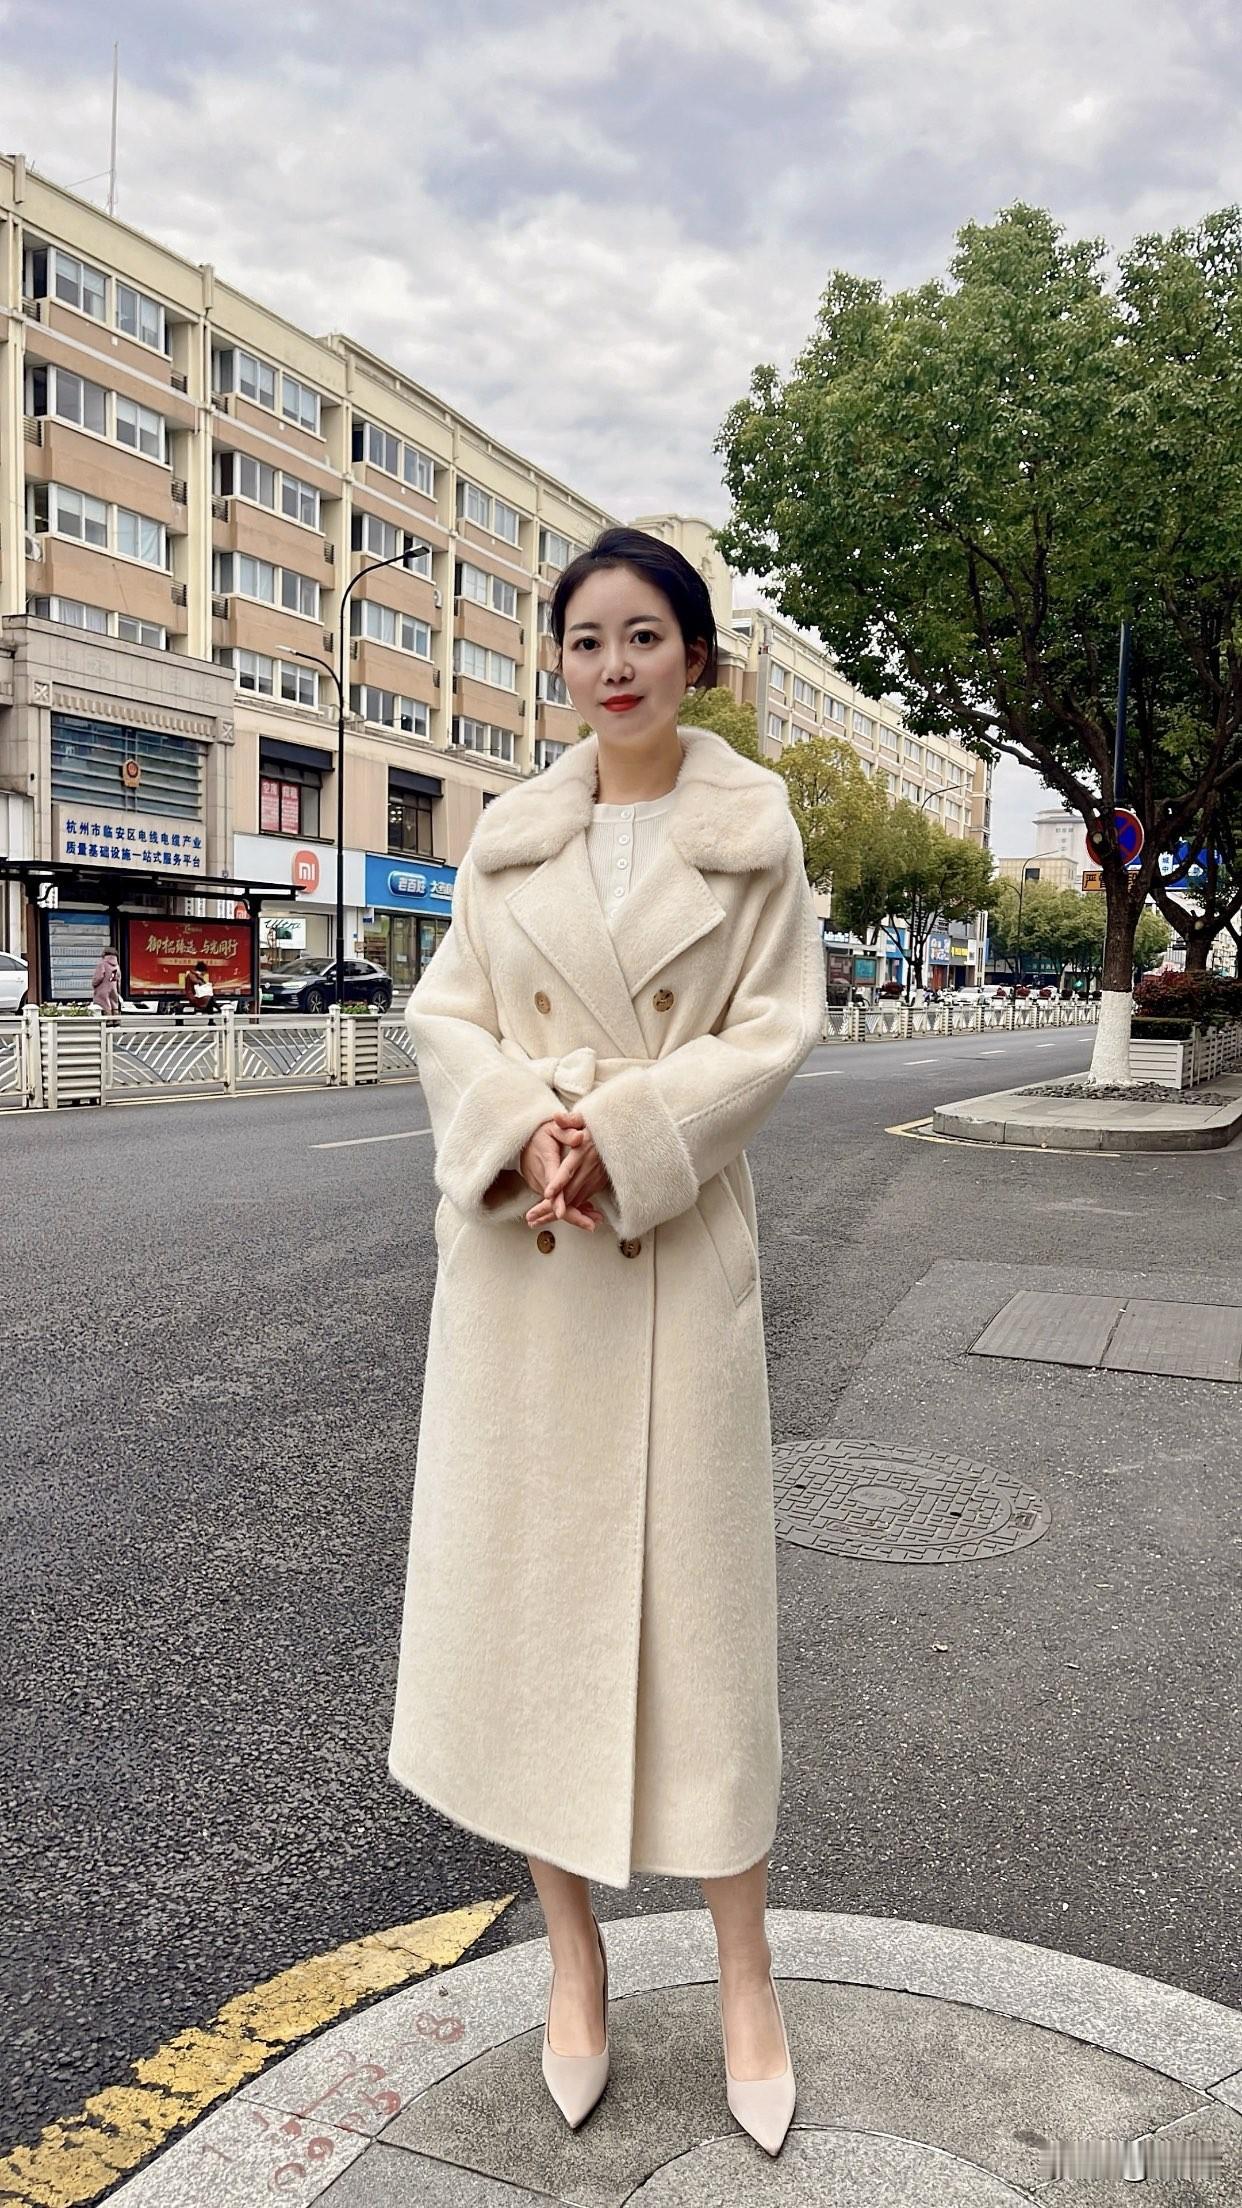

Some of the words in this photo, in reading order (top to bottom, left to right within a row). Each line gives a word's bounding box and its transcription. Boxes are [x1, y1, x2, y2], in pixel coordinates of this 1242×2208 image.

[66, 819, 202, 849] 杭州市临安区电线电缆产业
[66, 841, 201, 868] 质量基础设施一站式服务平台
